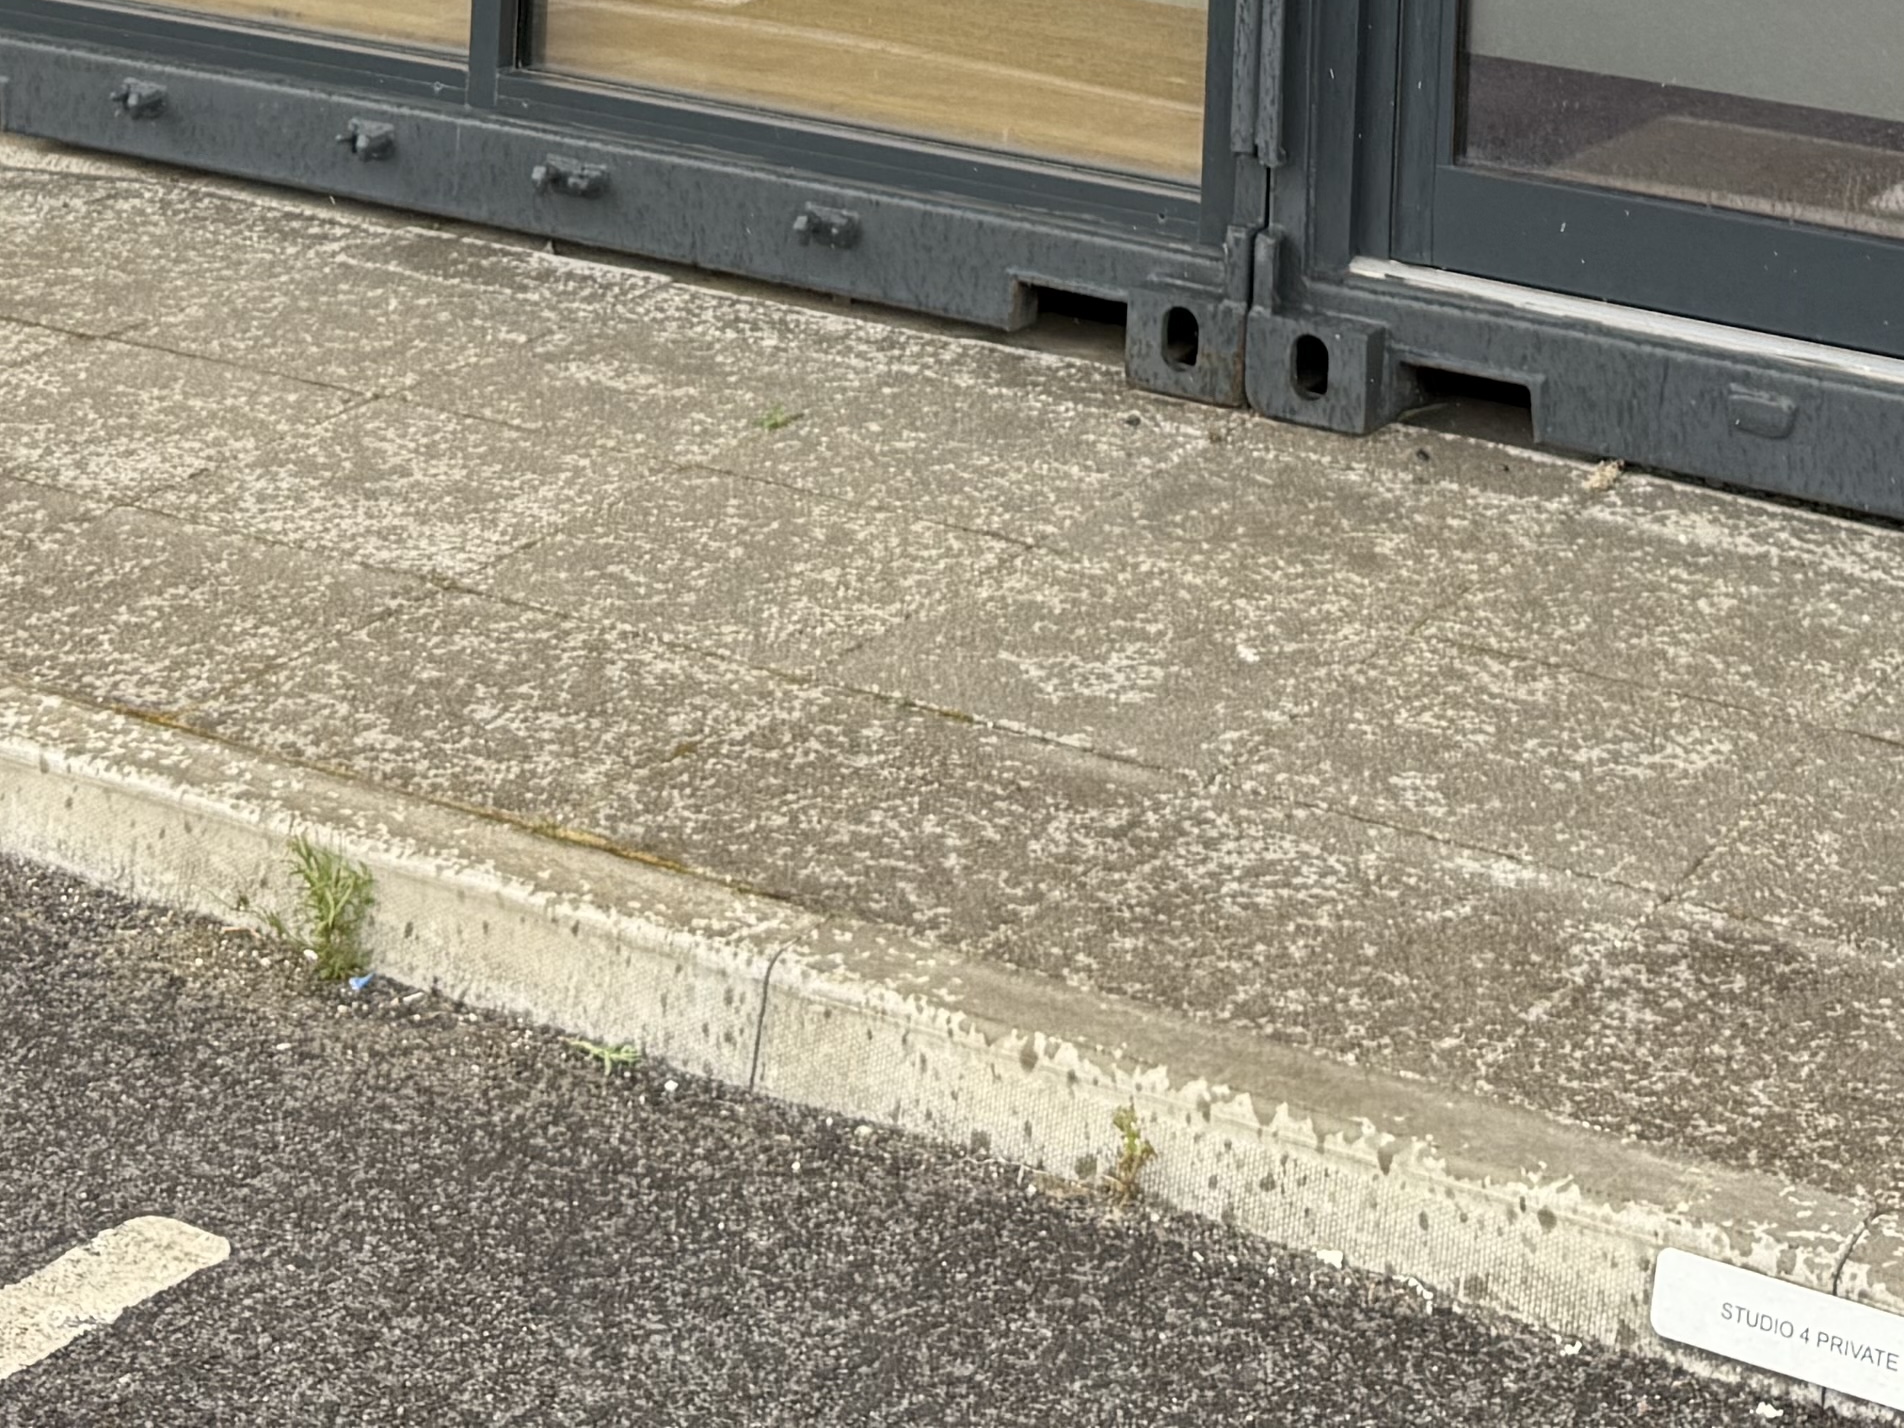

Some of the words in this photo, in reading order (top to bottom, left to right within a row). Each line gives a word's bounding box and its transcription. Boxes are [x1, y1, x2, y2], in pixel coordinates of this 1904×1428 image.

[1720, 1301, 1795, 1339] STUDIO
[1798, 1327, 1810, 1345] 4
[1815, 1331, 1900, 1373] PRIVATE
